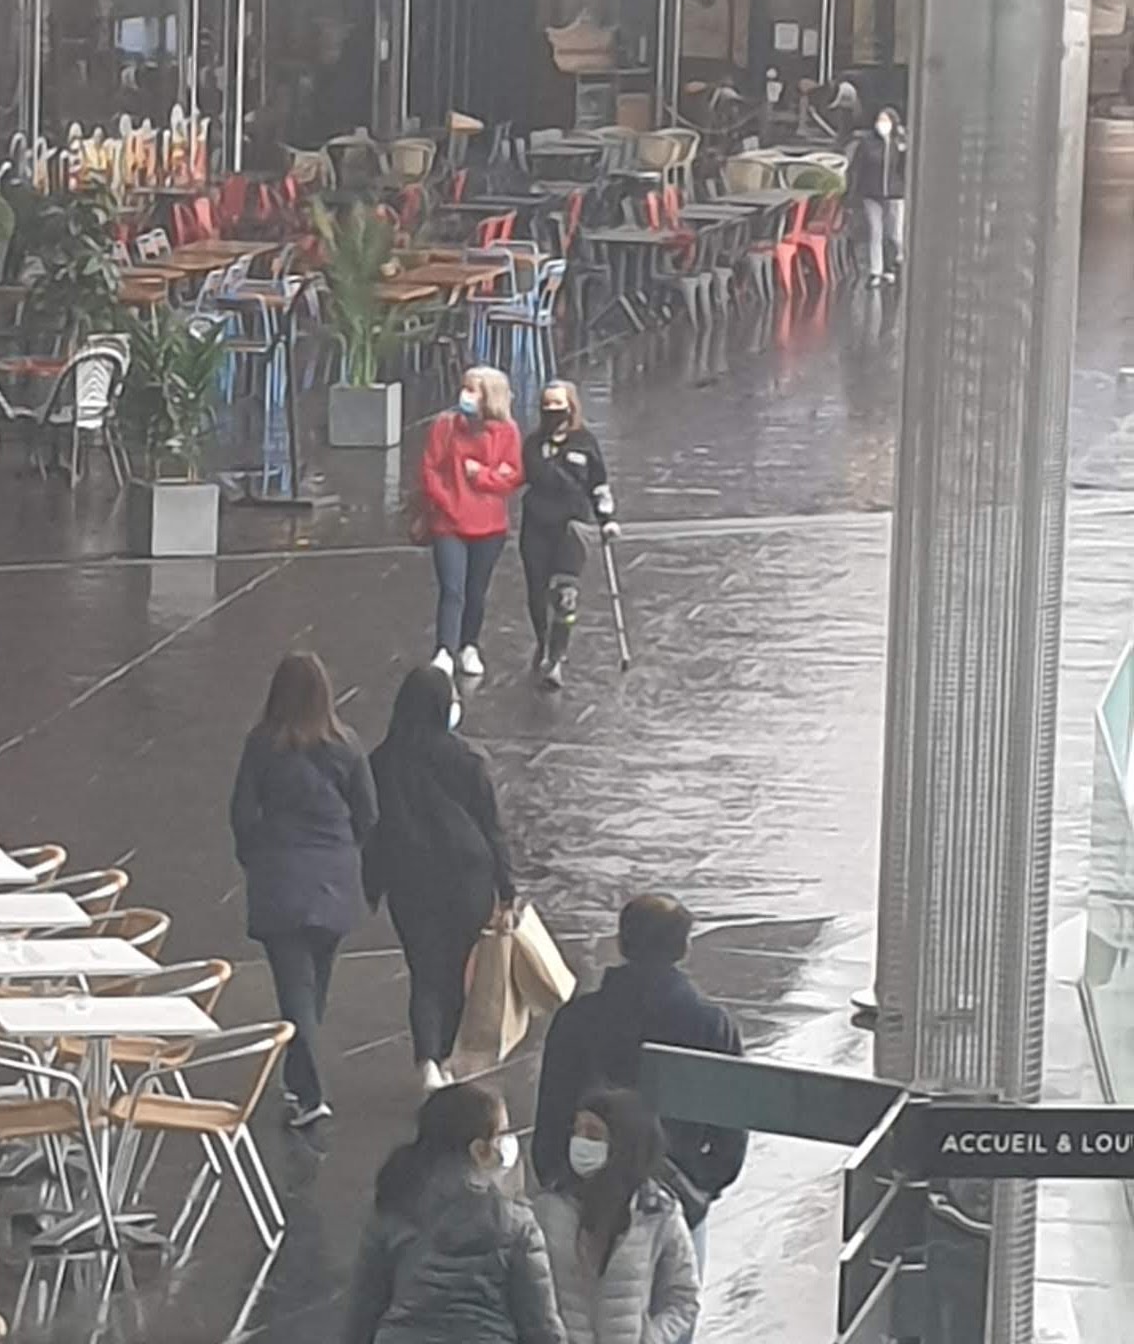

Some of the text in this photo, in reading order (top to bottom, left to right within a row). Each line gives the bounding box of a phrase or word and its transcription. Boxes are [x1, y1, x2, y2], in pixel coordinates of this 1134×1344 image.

[941, 1132, 1134, 1154] ACCUEIL & LOU
